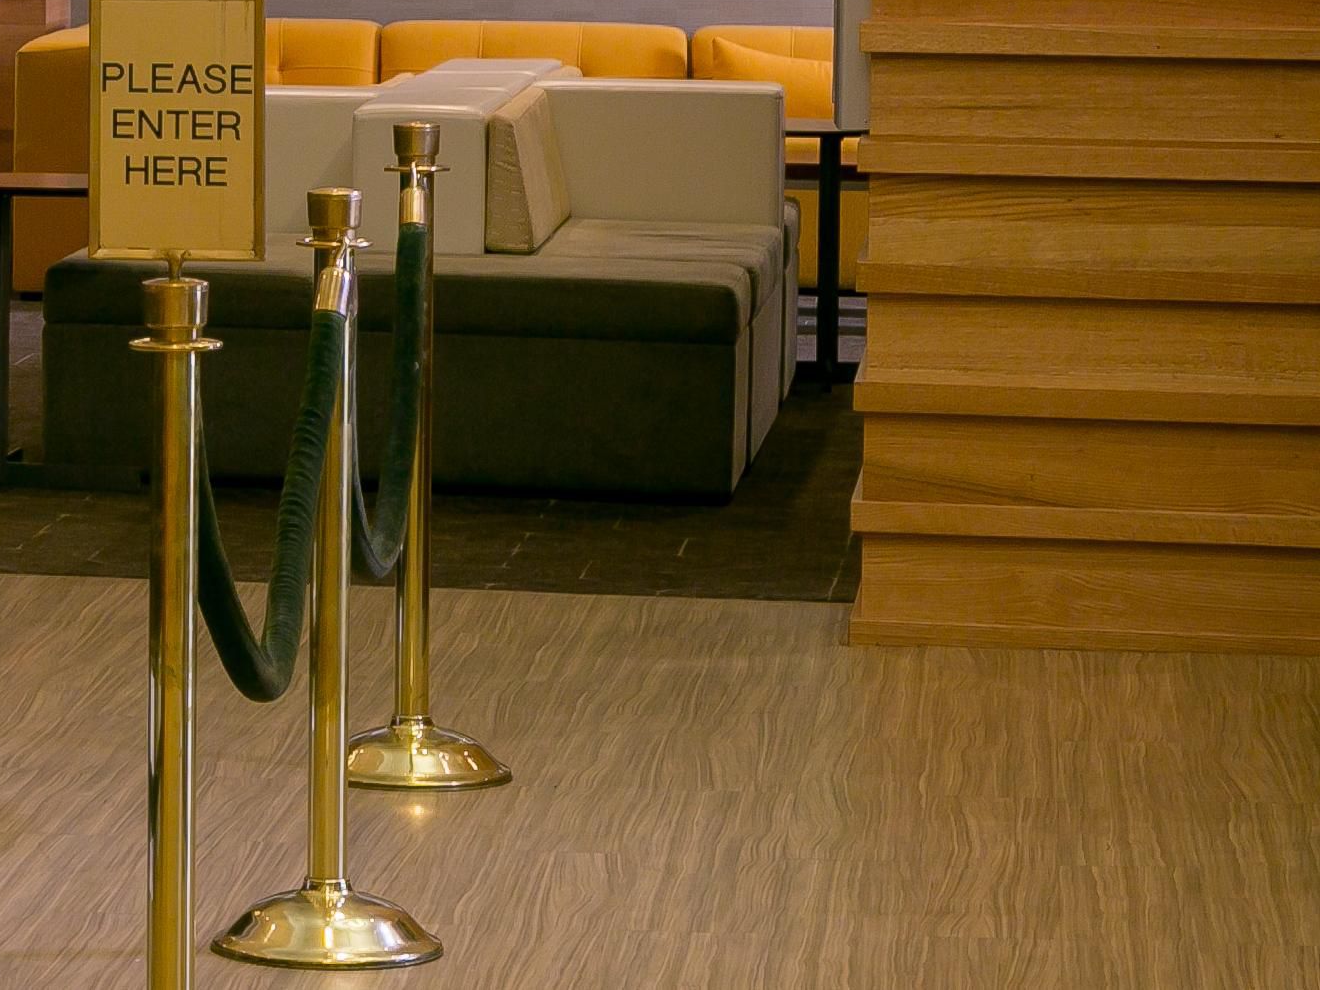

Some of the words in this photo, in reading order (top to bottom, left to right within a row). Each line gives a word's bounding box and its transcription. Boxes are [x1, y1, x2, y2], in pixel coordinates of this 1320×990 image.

[102, 63, 253, 95] PLEASE
[112, 109, 241, 141] ENTER
[125, 155, 228, 187] HERE
